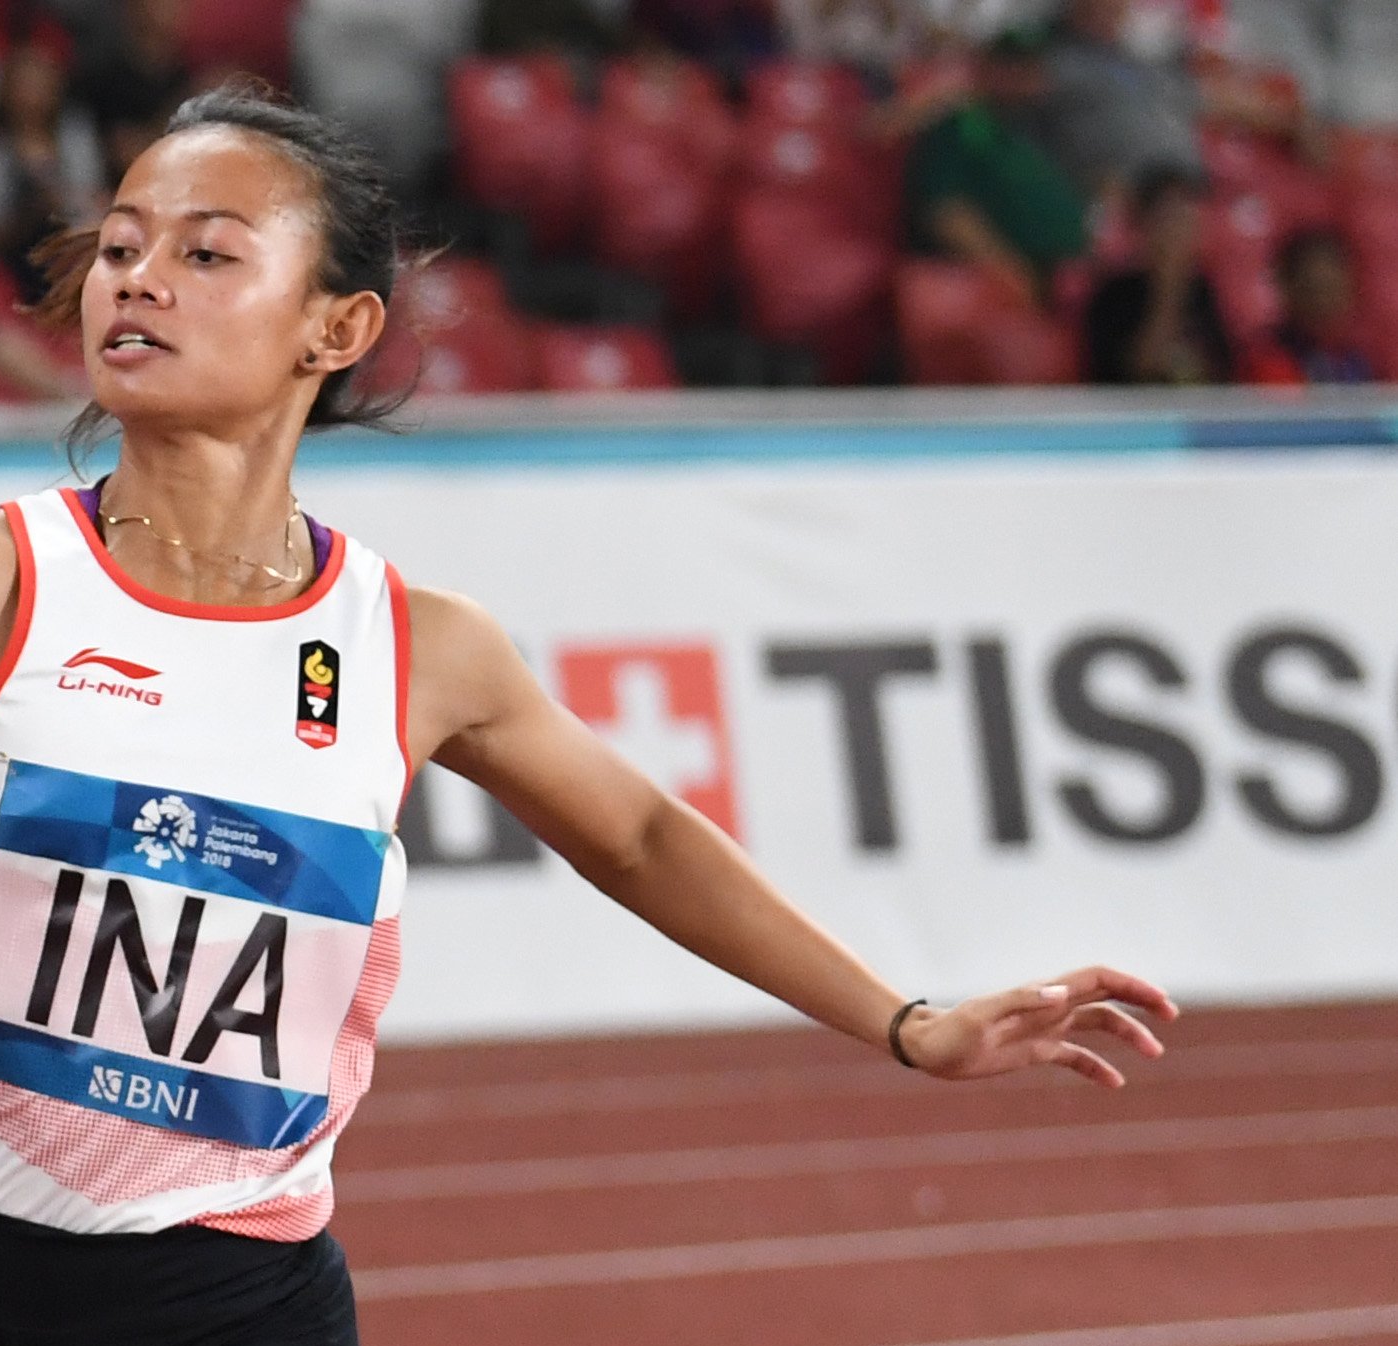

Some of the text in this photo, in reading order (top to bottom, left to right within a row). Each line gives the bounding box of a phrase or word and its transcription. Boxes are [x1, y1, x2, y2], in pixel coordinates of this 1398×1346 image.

[57, 674, 163, 706] LI-NING
[764, 624, 1398, 850] TISS
[207, 824, 258, 845] Jakarta
[200, 850, 232, 869] 2018
[204, 836, 278, 866] Palembang
[24, 868, 289, 1081] INA
[125, 1074, 199, 1121] BNI
